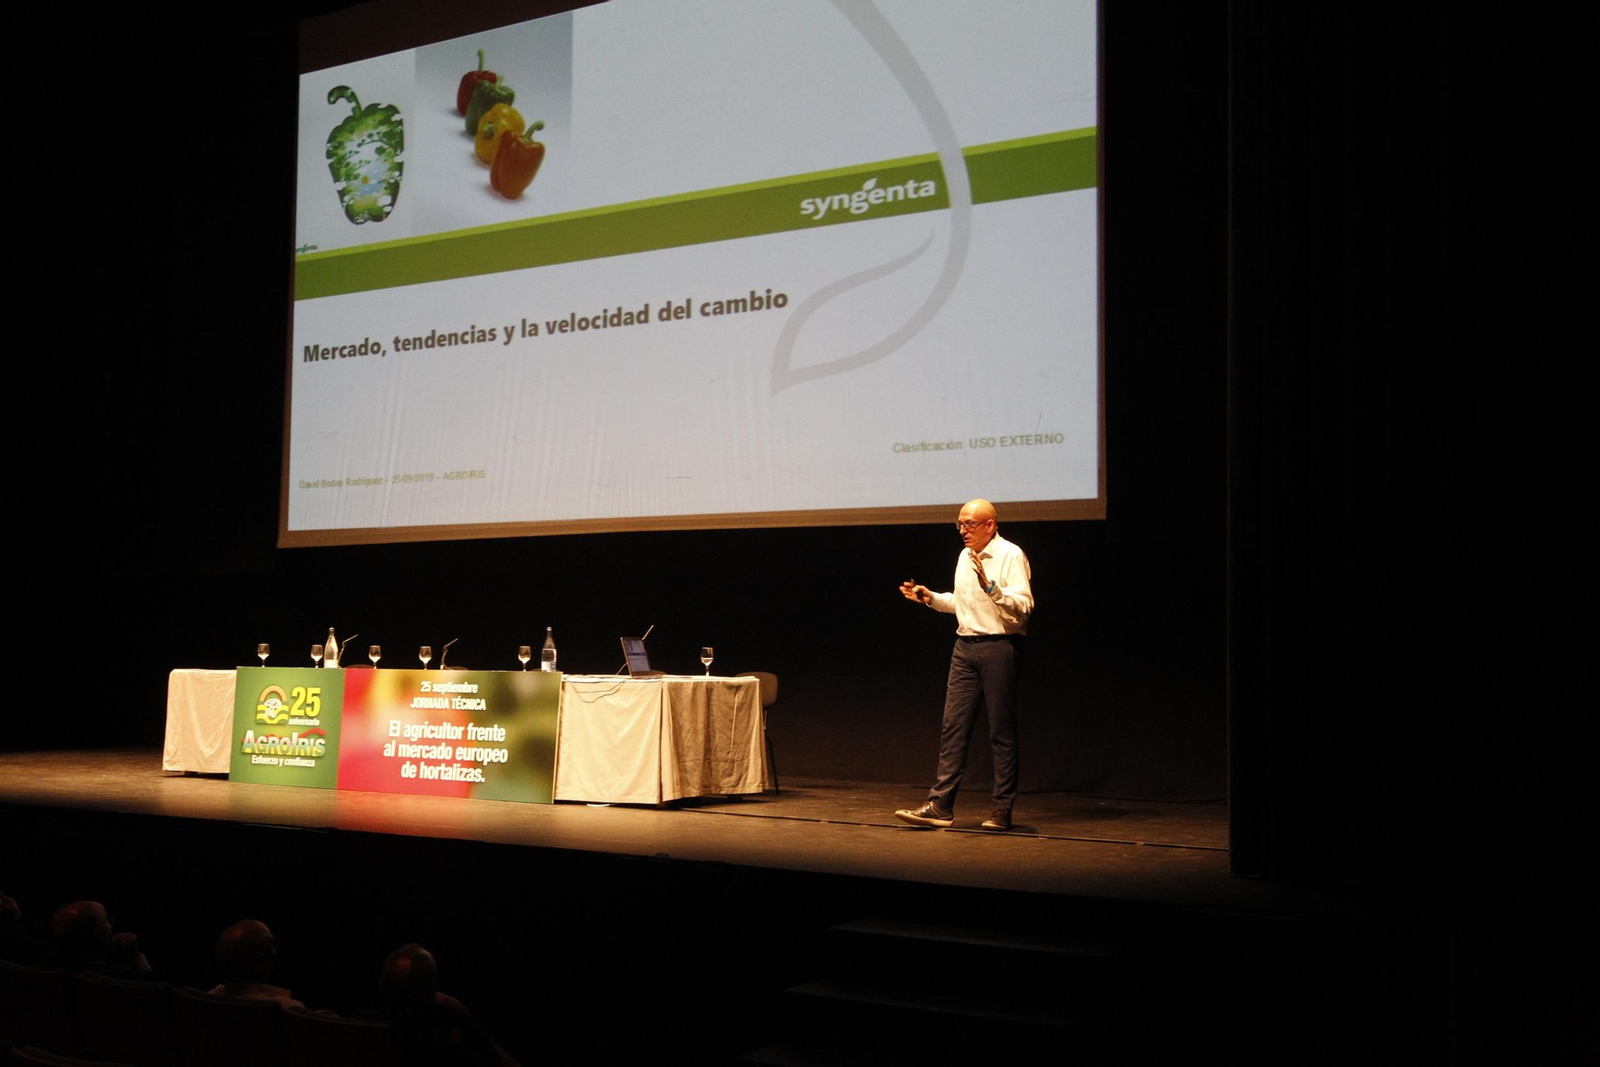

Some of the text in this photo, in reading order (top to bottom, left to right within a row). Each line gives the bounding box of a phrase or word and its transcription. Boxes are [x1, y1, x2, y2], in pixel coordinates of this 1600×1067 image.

[800, 178, 937, 220] syngenta
[303, 289, 789, 363] Mercado, tendencias y la velocidad del cambio
[968, 437, 996, 450] USO
[1000, 433, 1064, 447] EXTERNO
[420, 681, 478, 695] 25 septiembre
[290, 686, 321, 717] 25
[410, 696, 486, 711] JORNADA TÉCNICA
[288, 718, 320, 727] aniversario
[389, 720, 506, 742] El agricultor frente
[251, 755, 315, 767] Esfuerzo y confianza
[383, 740, 508, 765] al mercado europeo
[401, 761, 486, 782] de hortalizas.
